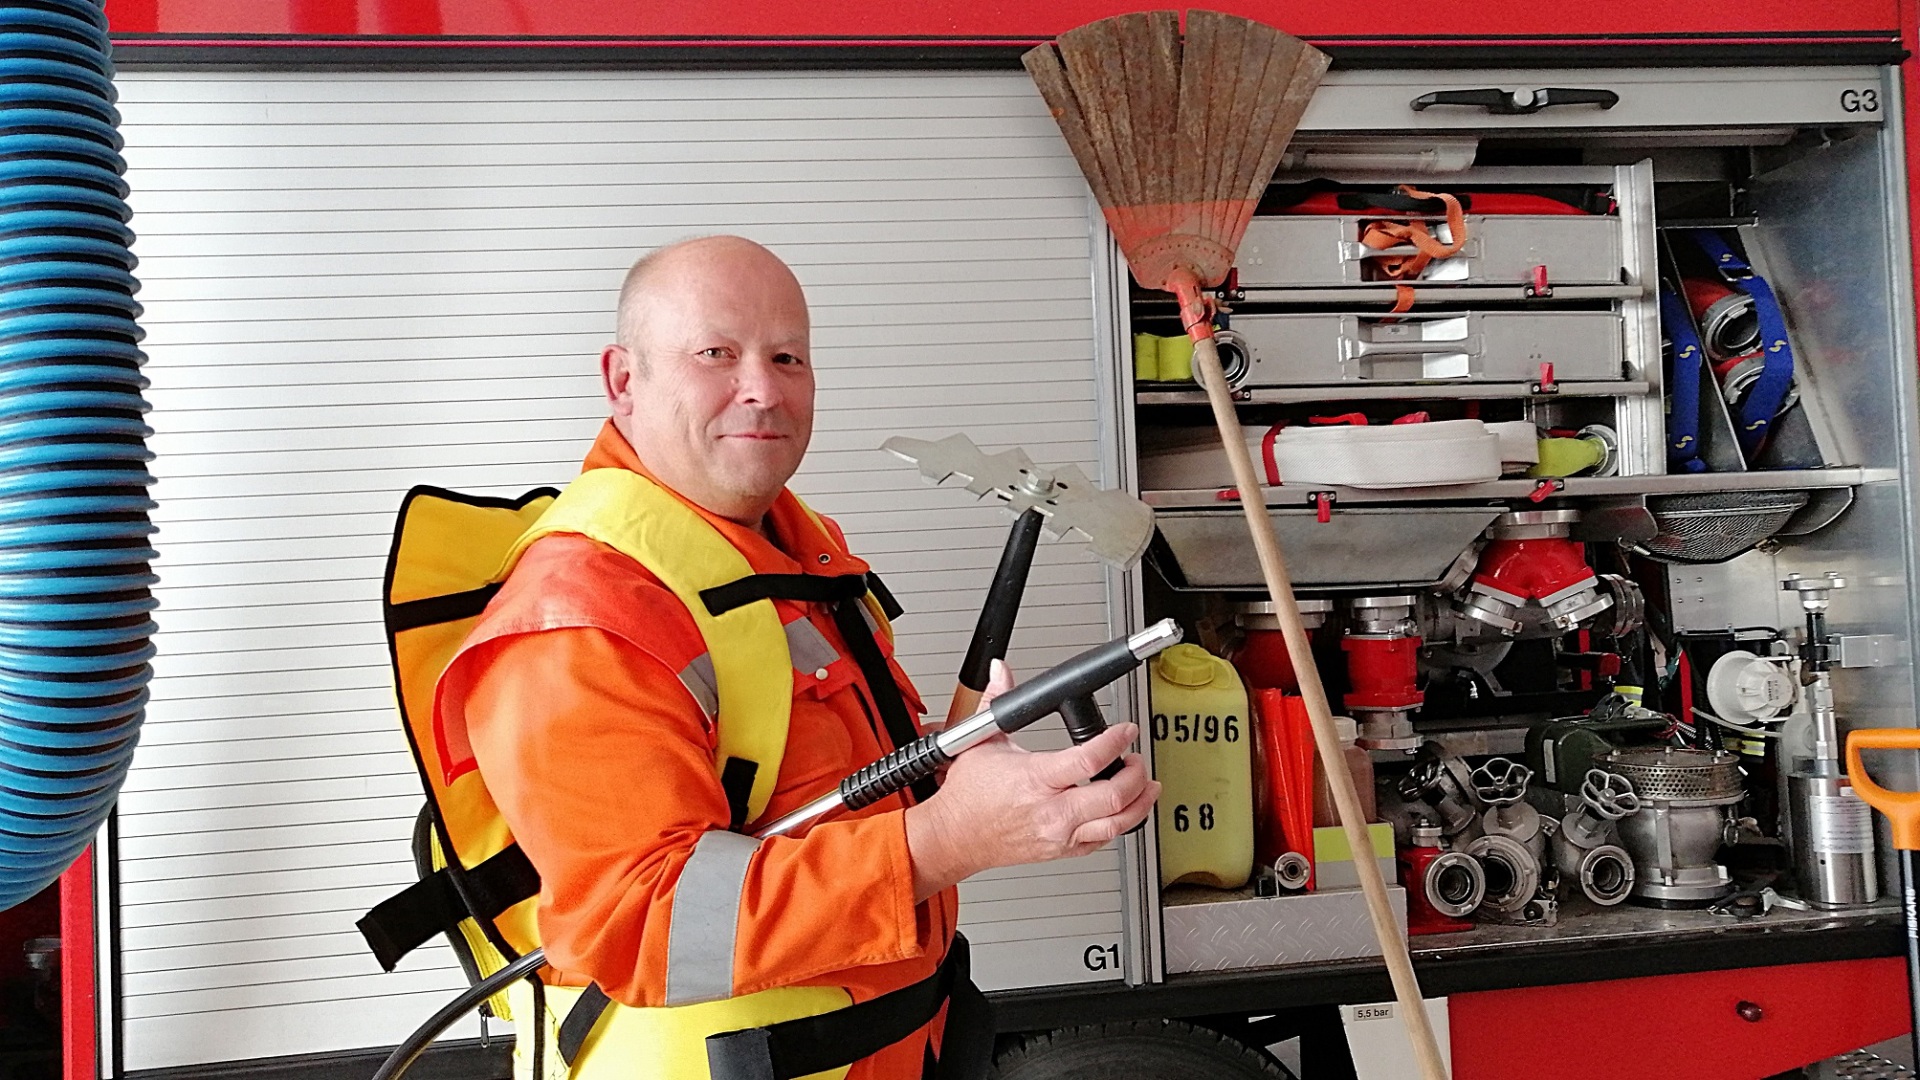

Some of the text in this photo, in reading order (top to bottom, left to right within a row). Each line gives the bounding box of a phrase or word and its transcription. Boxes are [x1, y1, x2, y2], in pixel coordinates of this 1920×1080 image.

[1840, 89, 1879, 113] G3
[1153, 713, 1239, 743] 05/96
[1083, 943, 1120, 972] G1
[1357, 1008, 1389, 1019] 5,5 bar
